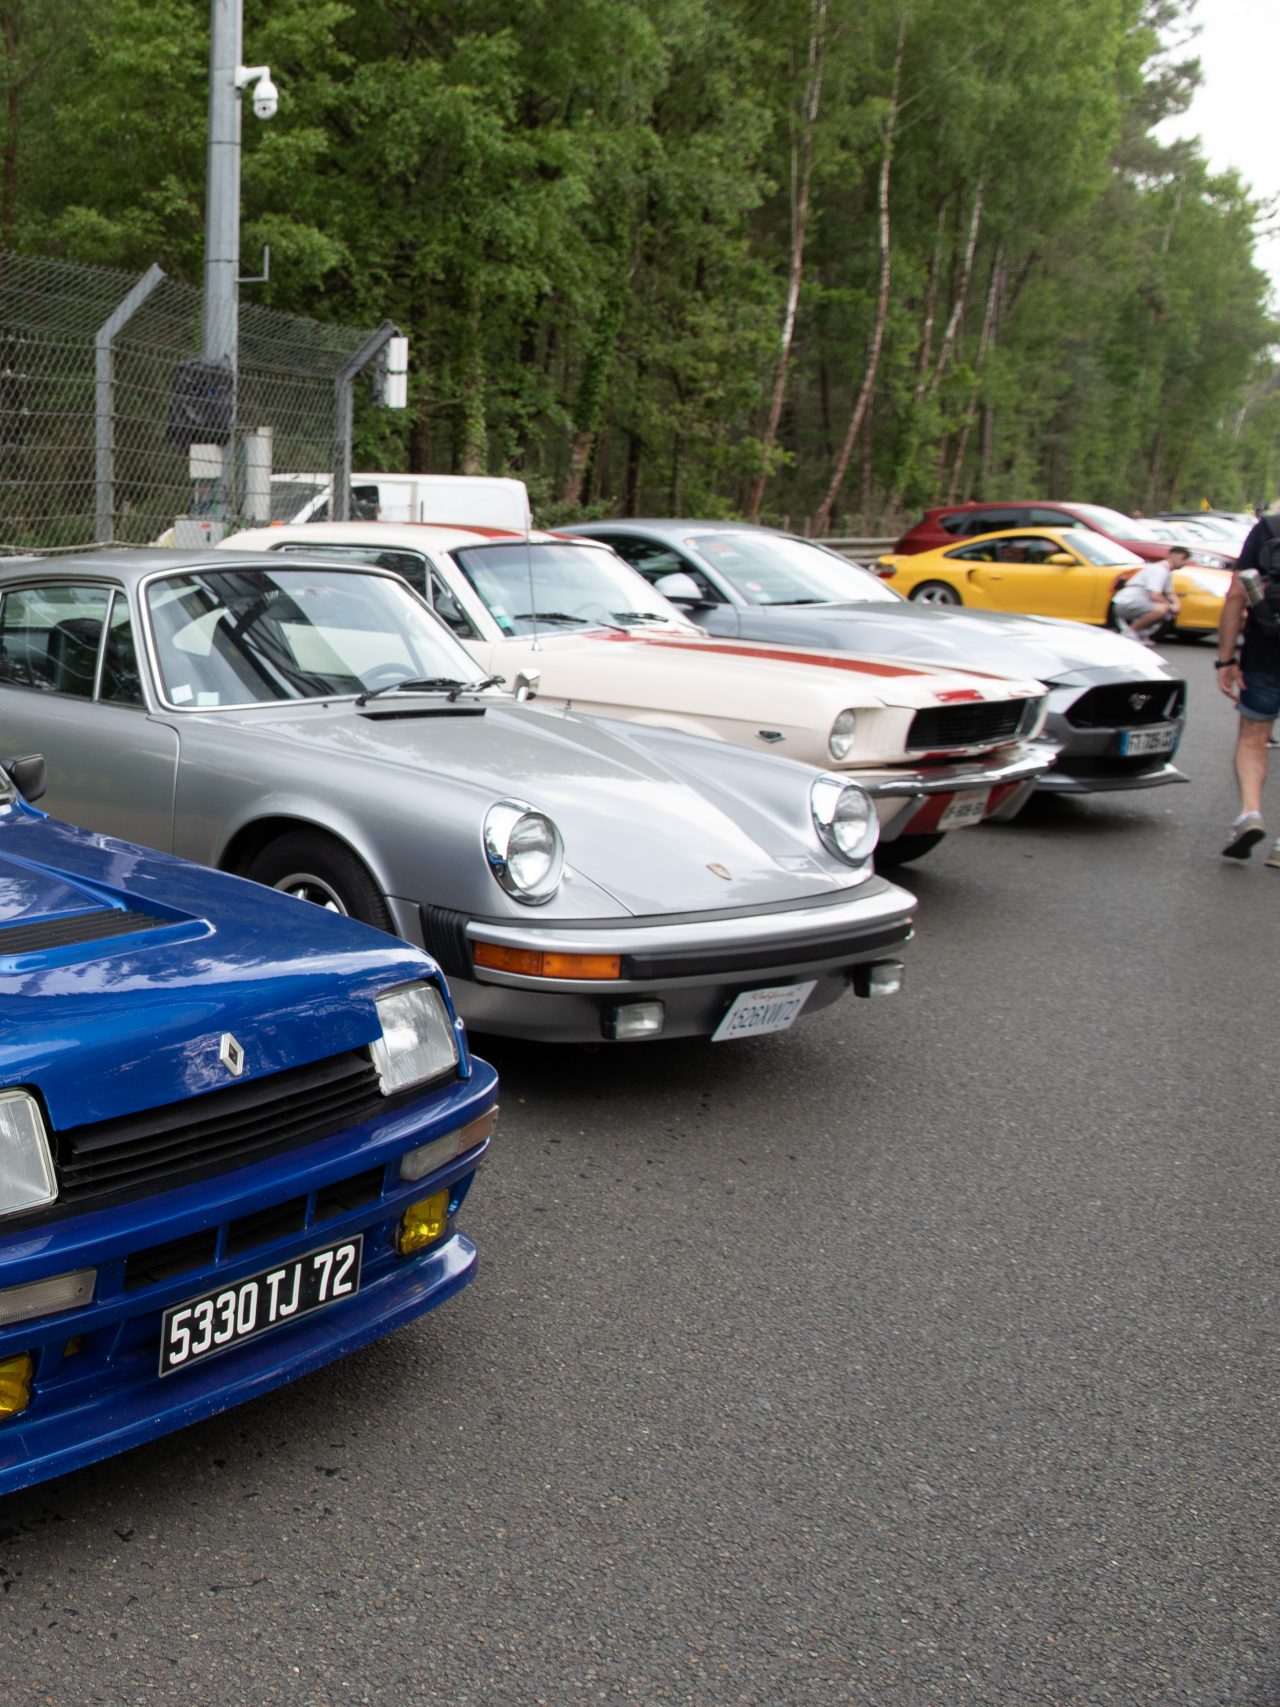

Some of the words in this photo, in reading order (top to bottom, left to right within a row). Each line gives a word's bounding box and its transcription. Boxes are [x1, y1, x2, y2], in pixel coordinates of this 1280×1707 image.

[169, 1282, 259, 1365] 5330
[266, 1263, 302, 1322] TJ
[313, 1244, 356, 1302] 72
